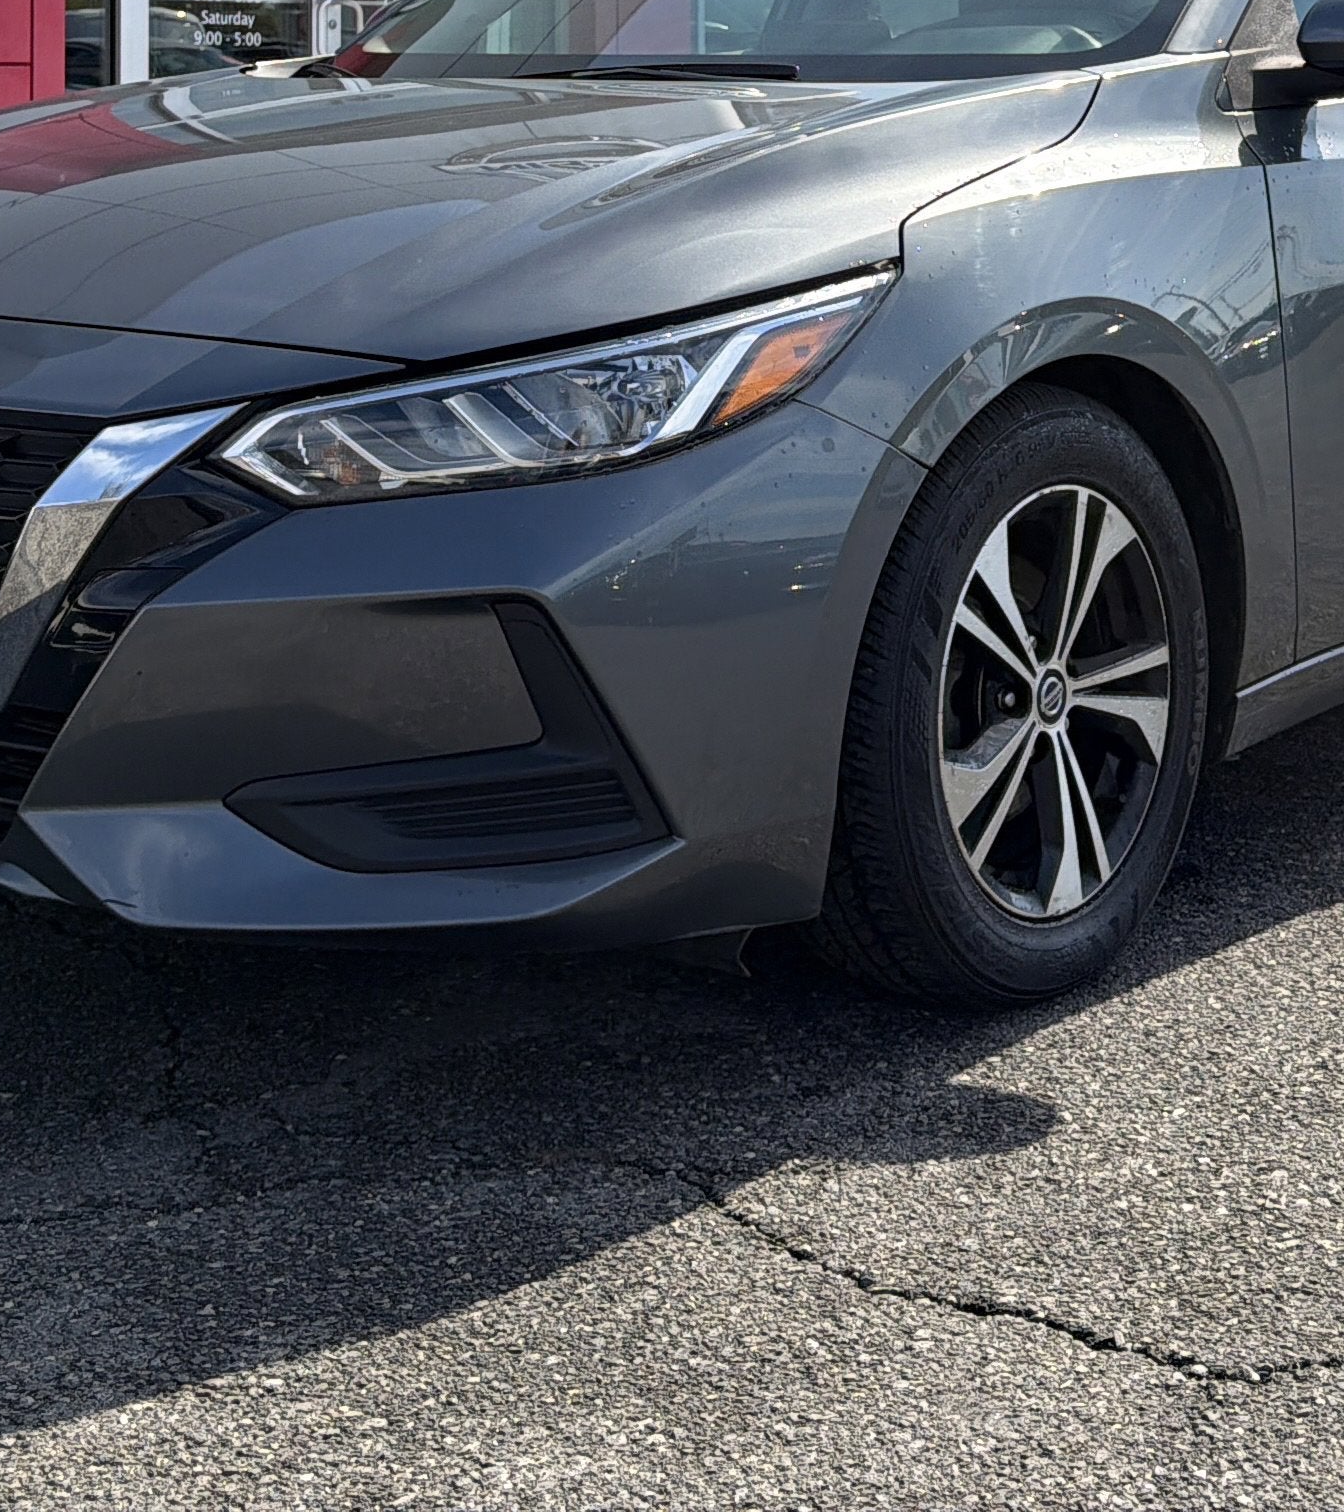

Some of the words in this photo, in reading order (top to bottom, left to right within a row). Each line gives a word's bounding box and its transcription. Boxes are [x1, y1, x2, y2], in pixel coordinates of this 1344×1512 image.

[201, 10, 256, 28] Saturday
[193, 31, 222, 45] 9:00
[233, 31, 262, 46] 5:00
